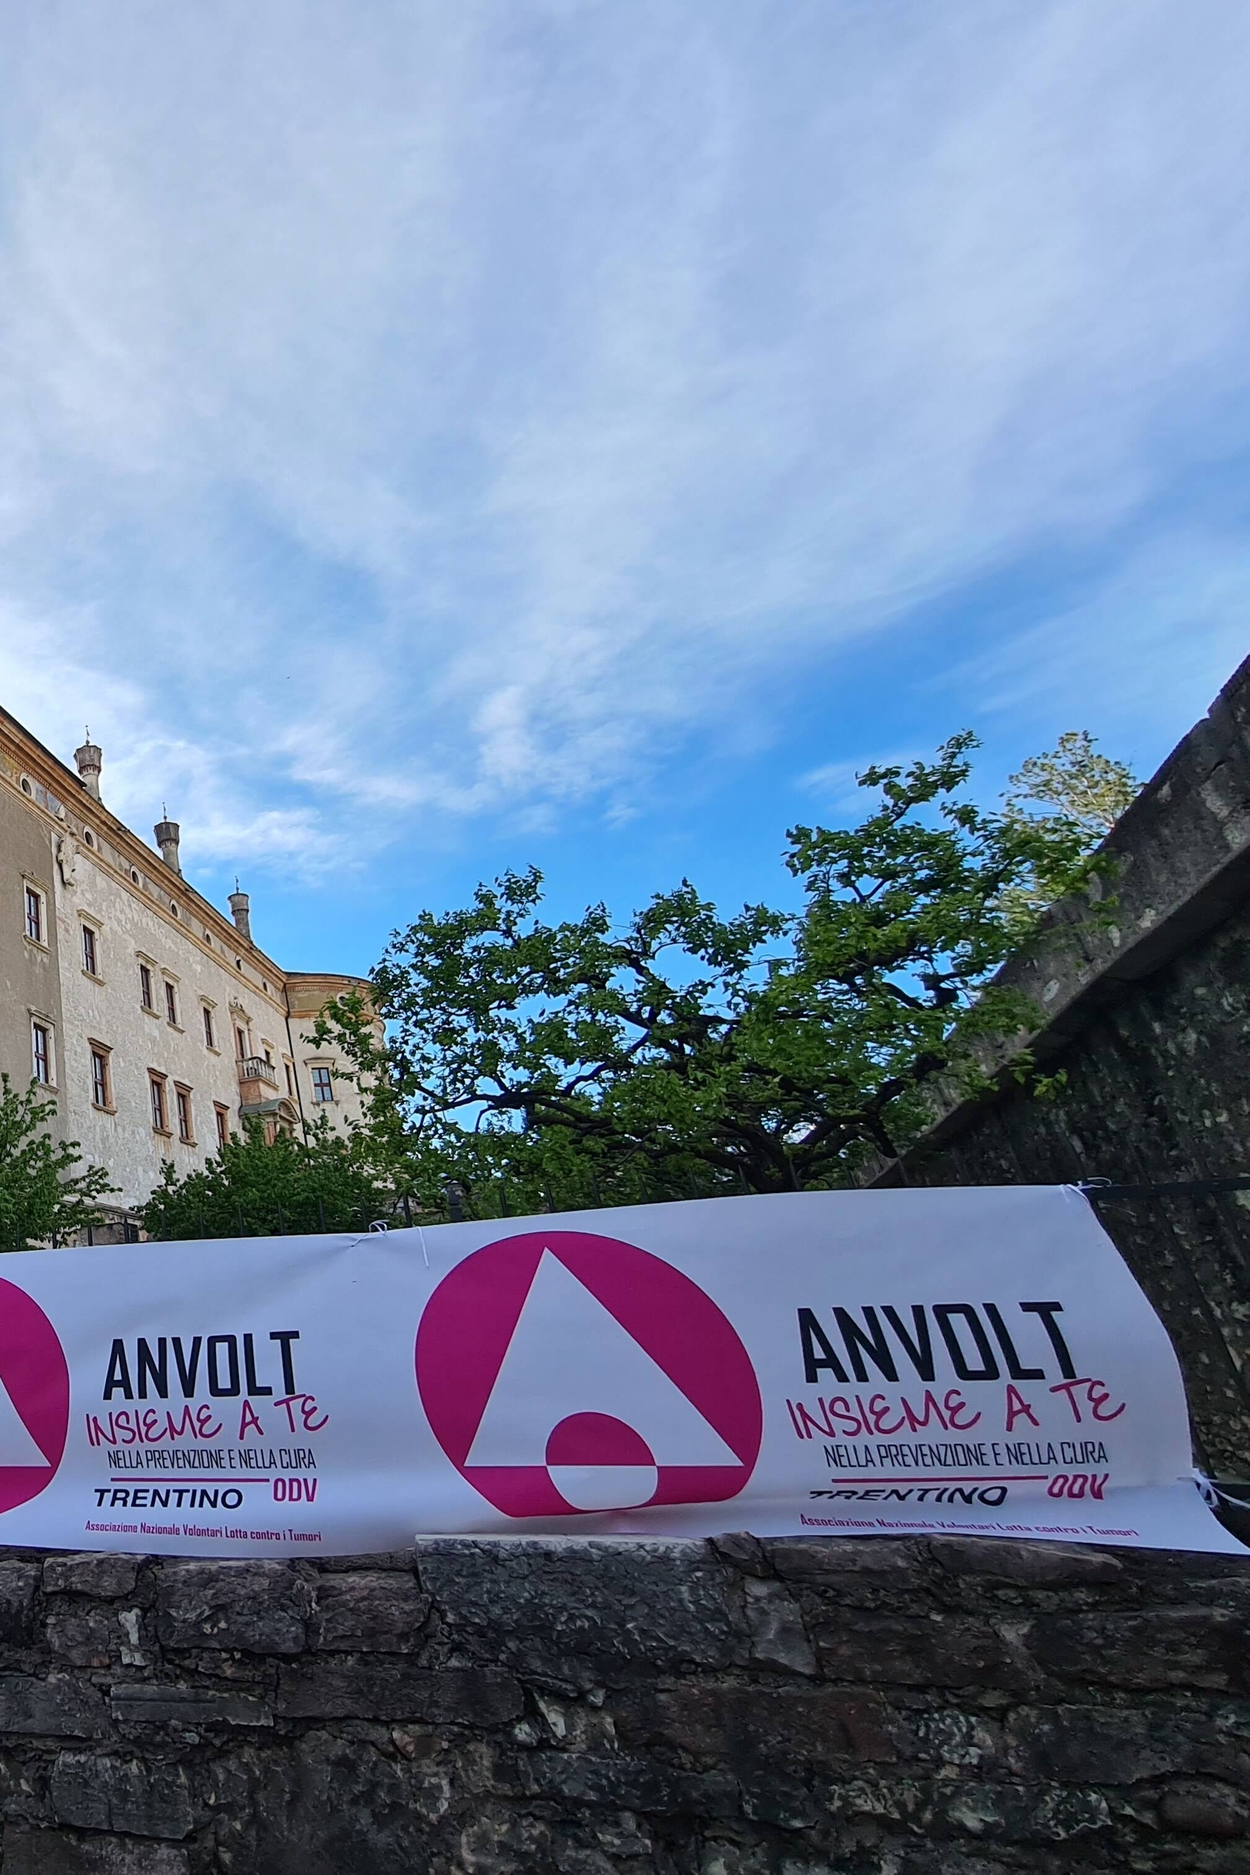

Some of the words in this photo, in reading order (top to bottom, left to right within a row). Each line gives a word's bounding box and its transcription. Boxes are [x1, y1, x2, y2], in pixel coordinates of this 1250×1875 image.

[796, 1301, 1077, 1384] ANVOLT
[103, 1331, 300, 1400] ANVOLT
[85, 1403, 223, 1447] INSIEME
[239, 1399, 265, 1440] A
[273, 1394, 330, 1433] TE
[786, 1388, 981, 1440] INSIEME
[1005, 1384, 1040, 1432] A
[1049, 1378, 1126, 1423] TE
[107, 1449, 144, 1469] NELLA
[146, 1449, 226, 1469] PREVENZIONE
[229, 1449, 237, 1469] E
[239, 1449, 277, 1469] NELLA
[280, 1448, 317, 1469] CURA
[823, 1444, 876, 1468] NELLA
[879, 1443, 990, 1467] PREVENZIONE
[994, 1443, 1004, 1466] E
[1007, 1441, 1056, 1466] NELLA
[1060, 1440, 1108, 1465] CURA
[93, 1488, 244, 1509] TRENTINO
[273, 1477, 318, 1502] ODV
[809, 1486, 1008, 1507] TRENTINO
[1047, 1472, 1110, 1501] ODV
[85, 1520, 138, 1533] Associazione
[140, 1522, 180, 1536] Nazionale
[182, 1524, 223, 1538] Volontari
[225, 1526, 248, 1539] Lotta
[250, 1529, 281, 1541] contro
[283, 1529, 287, 1541] i
[288, 1528, 322, 1542] Tumori
[800, 1513, 874, 1528] Associazione
[995, 1522, 1033, 1532] Lotta
[1034, 1525, 1080, 1534] contro
[1086, 1525, 1140, 1537] Tumori
